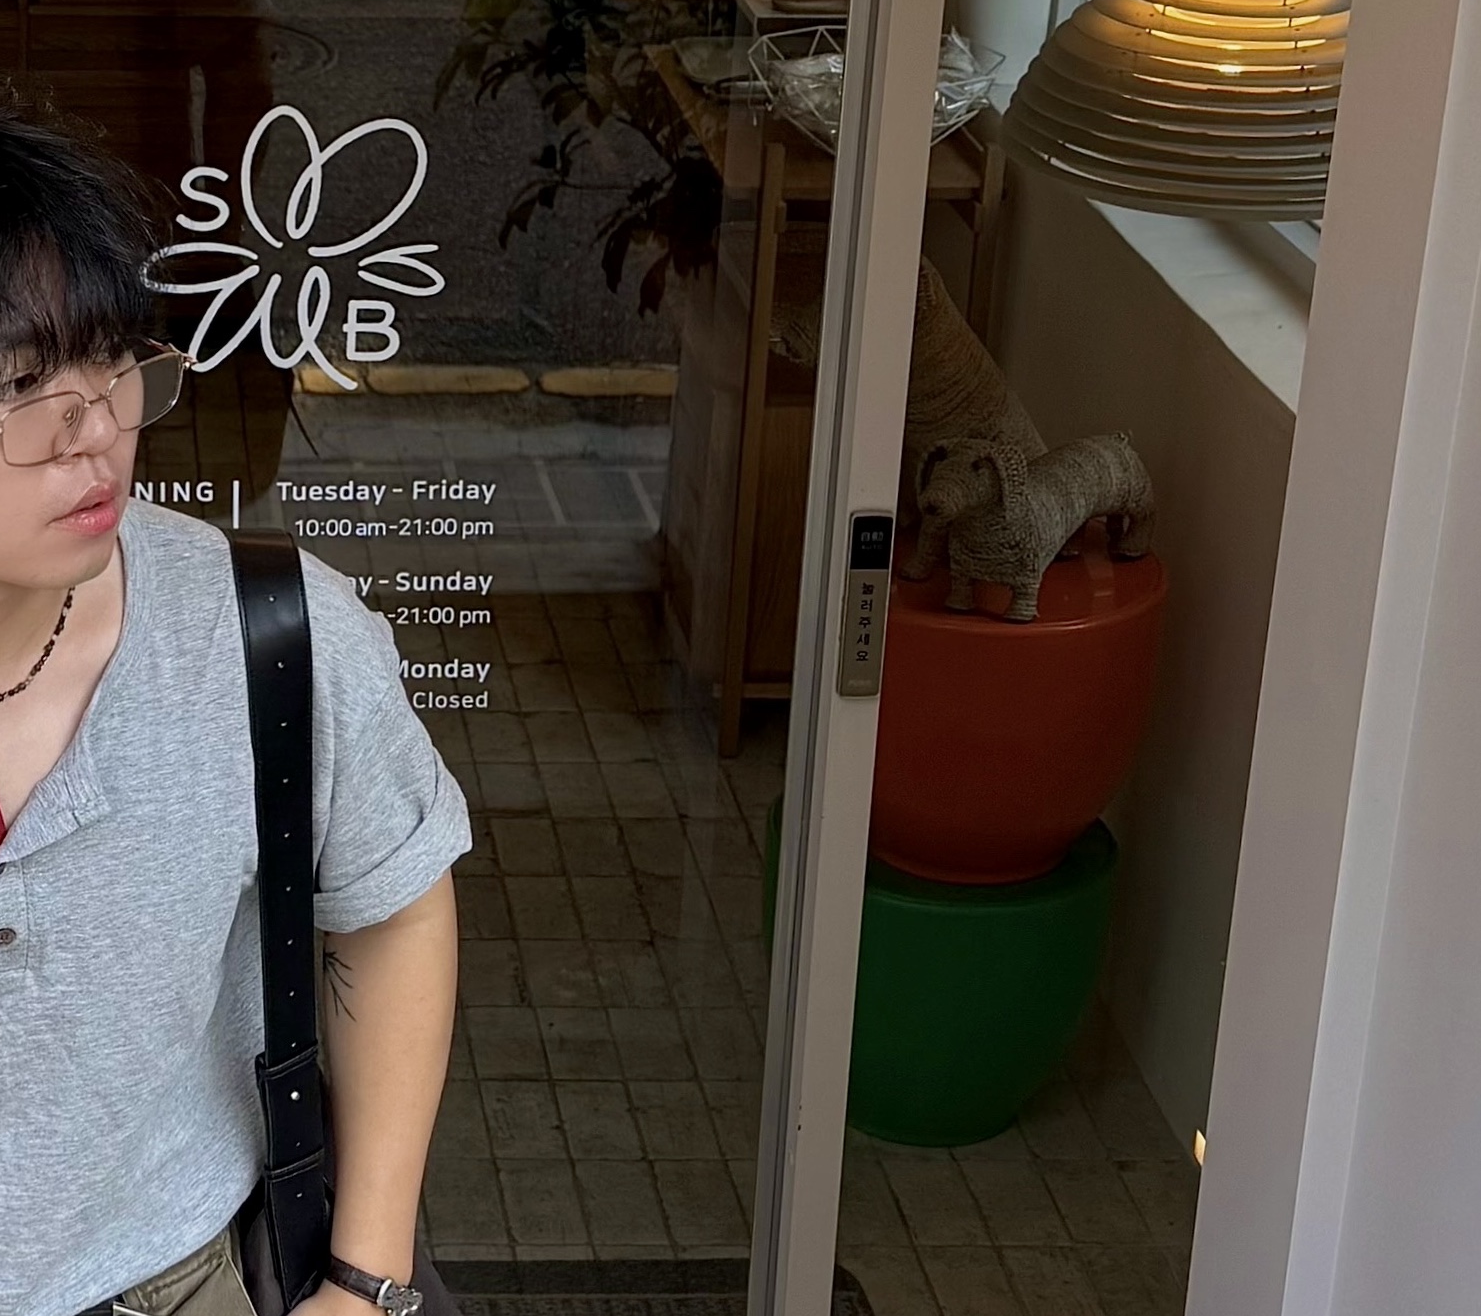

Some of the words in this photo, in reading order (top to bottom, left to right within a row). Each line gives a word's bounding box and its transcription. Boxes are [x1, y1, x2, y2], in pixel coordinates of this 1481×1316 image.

[175, 166, 230, 232] S
[342, 299, 400, 361] B
[275, 480, 387, 505] Tuesday
[412, 479, 496, 505] Friday
[294, 518, 352, 537] 10:00
[462, 521, 494, 540] pm
[395, 570, 493, 596] Sunday
[377, 607, 455, 625] -21:00
[459, 610, 491, 628] pm
[412, 691, 488, 709] Closed
